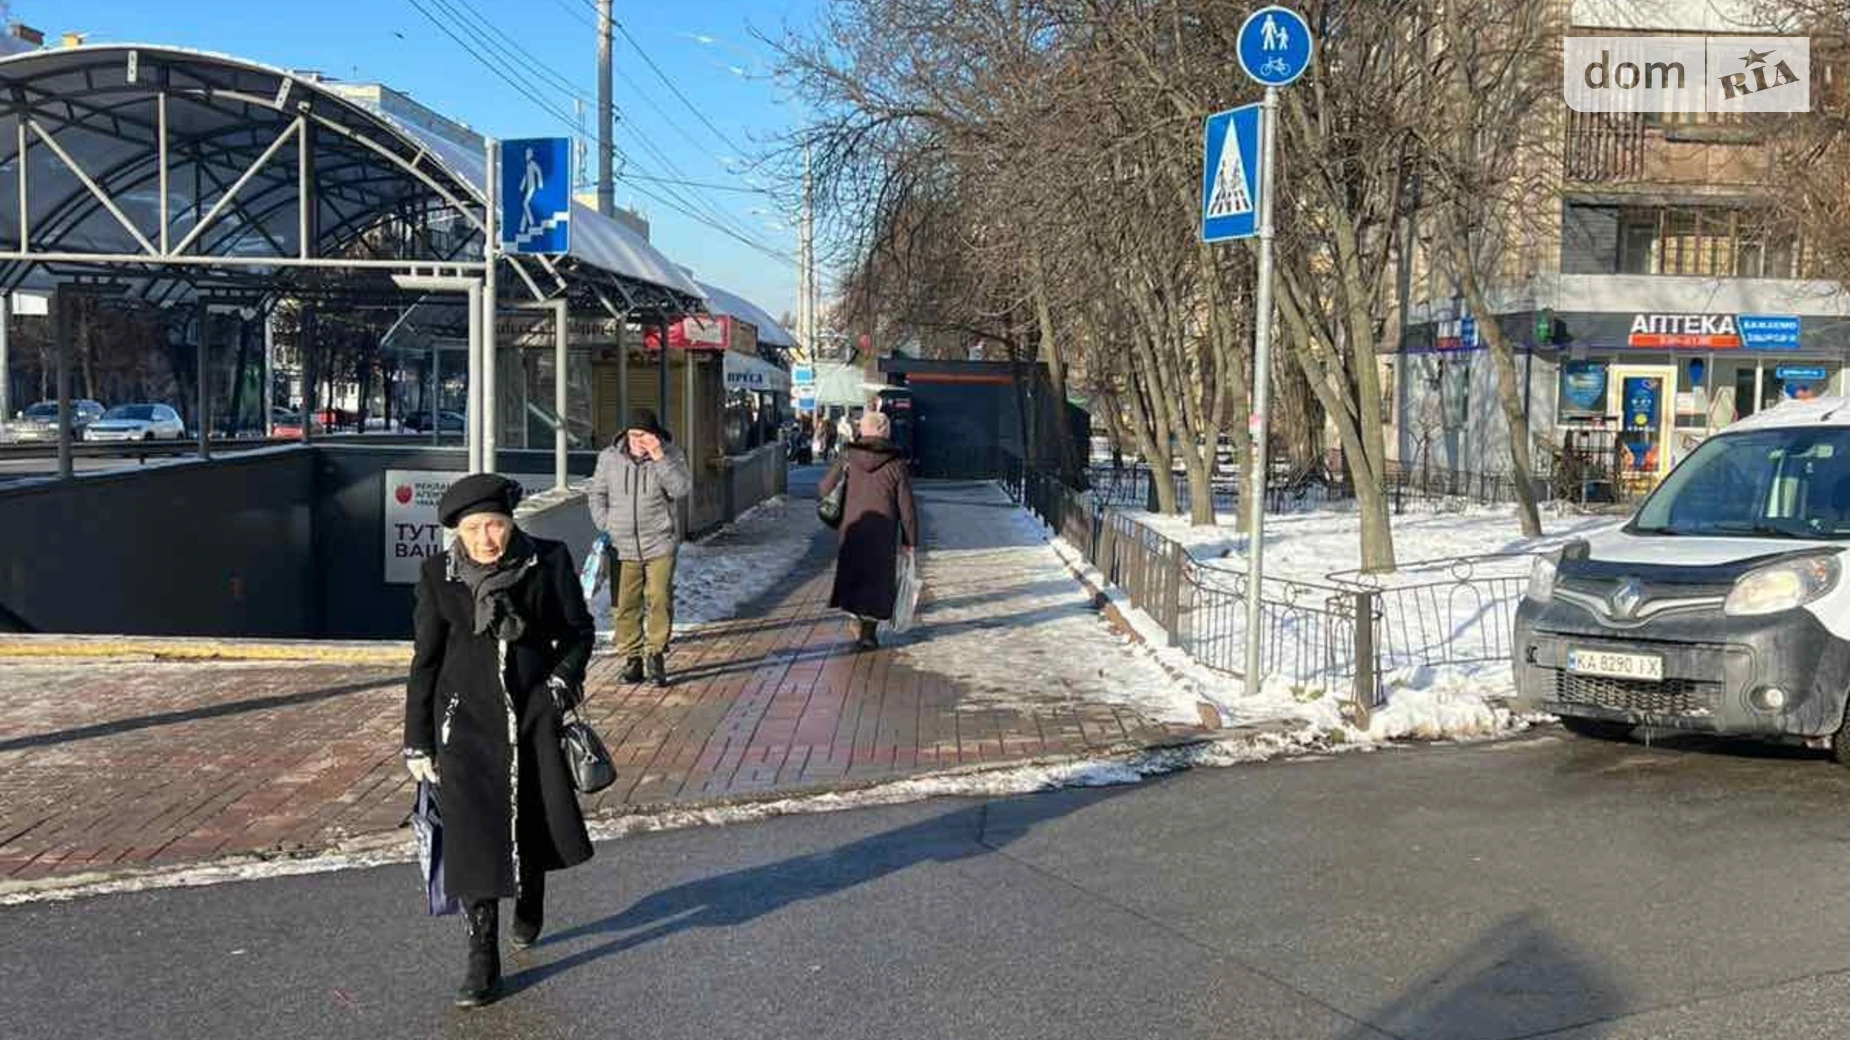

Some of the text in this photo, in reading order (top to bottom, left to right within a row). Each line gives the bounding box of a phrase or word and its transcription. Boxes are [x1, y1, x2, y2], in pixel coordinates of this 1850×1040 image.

[1630, 314, 1737, 335] АПТЕКА
[394, 523, 440, 541] ТУТ
[1600, 655, 1633, 674] 8290
